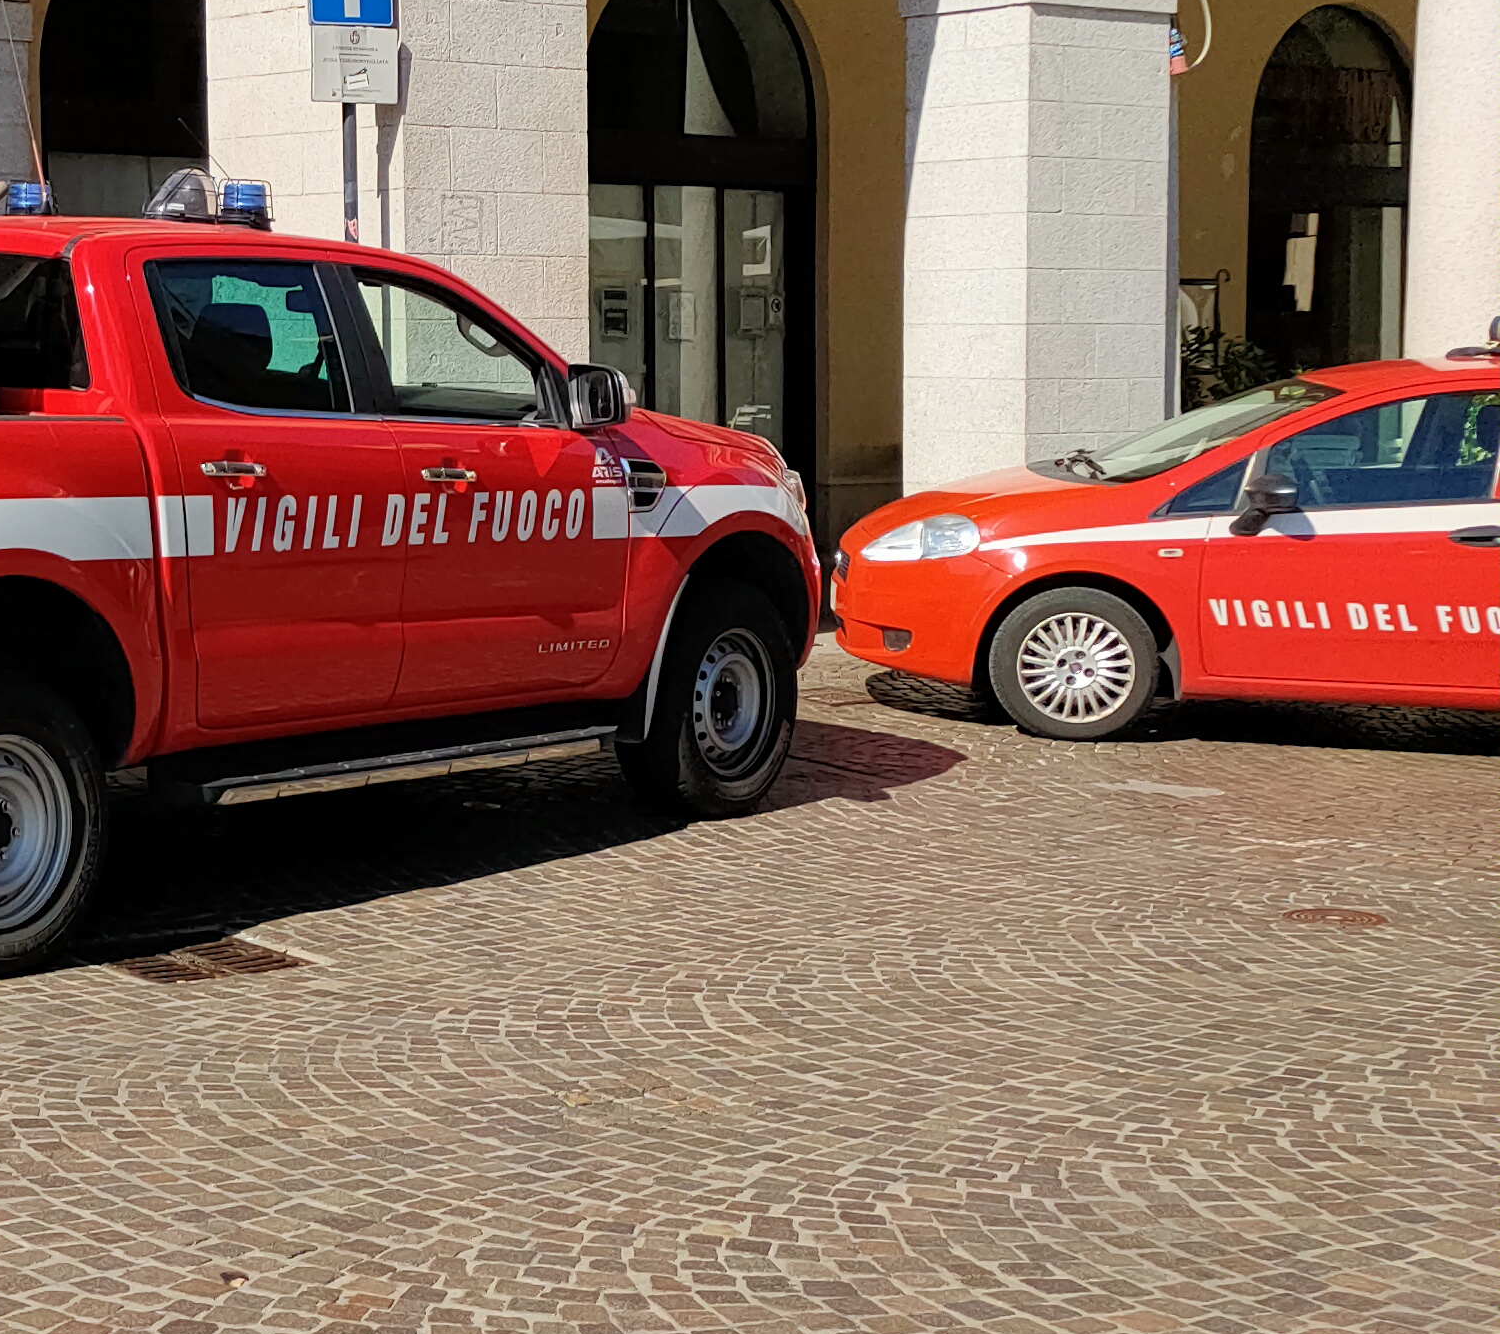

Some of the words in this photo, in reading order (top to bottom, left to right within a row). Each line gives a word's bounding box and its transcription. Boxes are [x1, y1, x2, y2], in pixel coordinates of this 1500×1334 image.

[224, 494, 363, 553] VIGILI
[381, 492, 450, 547] DEL
[467, 488, 586, 544] FUOCO
[1208, 598, 1331, 630] VIGILI
[1345, 602, 1419, 632] DEL
[537, 638, 610, 654] LIMITED
